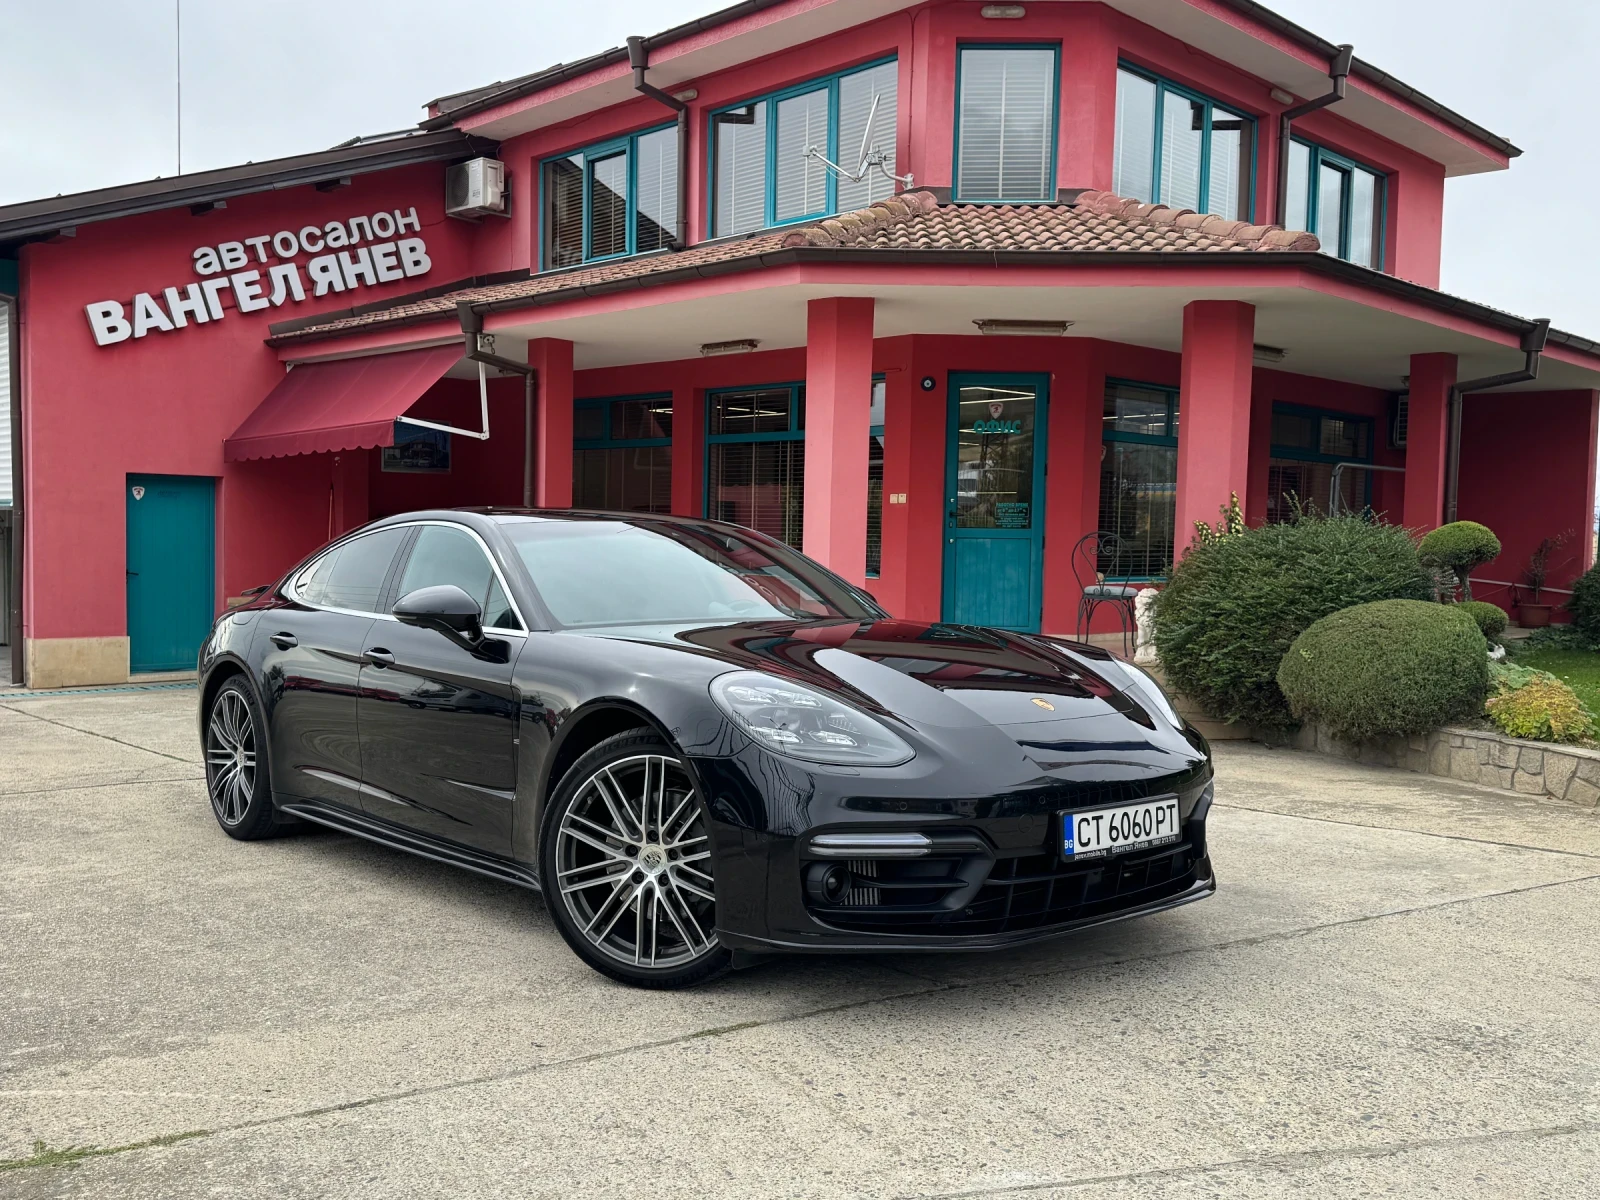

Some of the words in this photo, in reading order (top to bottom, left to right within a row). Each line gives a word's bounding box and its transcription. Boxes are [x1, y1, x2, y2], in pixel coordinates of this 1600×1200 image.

[192, 207, 421, 275] автосалон
[84, 262, 306, 346] ВАНГЕЛ
[306, 237, 432, 297] ЯНЕВ
[973, 420, 1022, 435] ОФИС
[1064, 839, 1074, 850] BG
[1077, 815, 1104, 848] CT
[1108, 808, 1153, 843] 6060
[1155, 804, 1176, 835] PT
